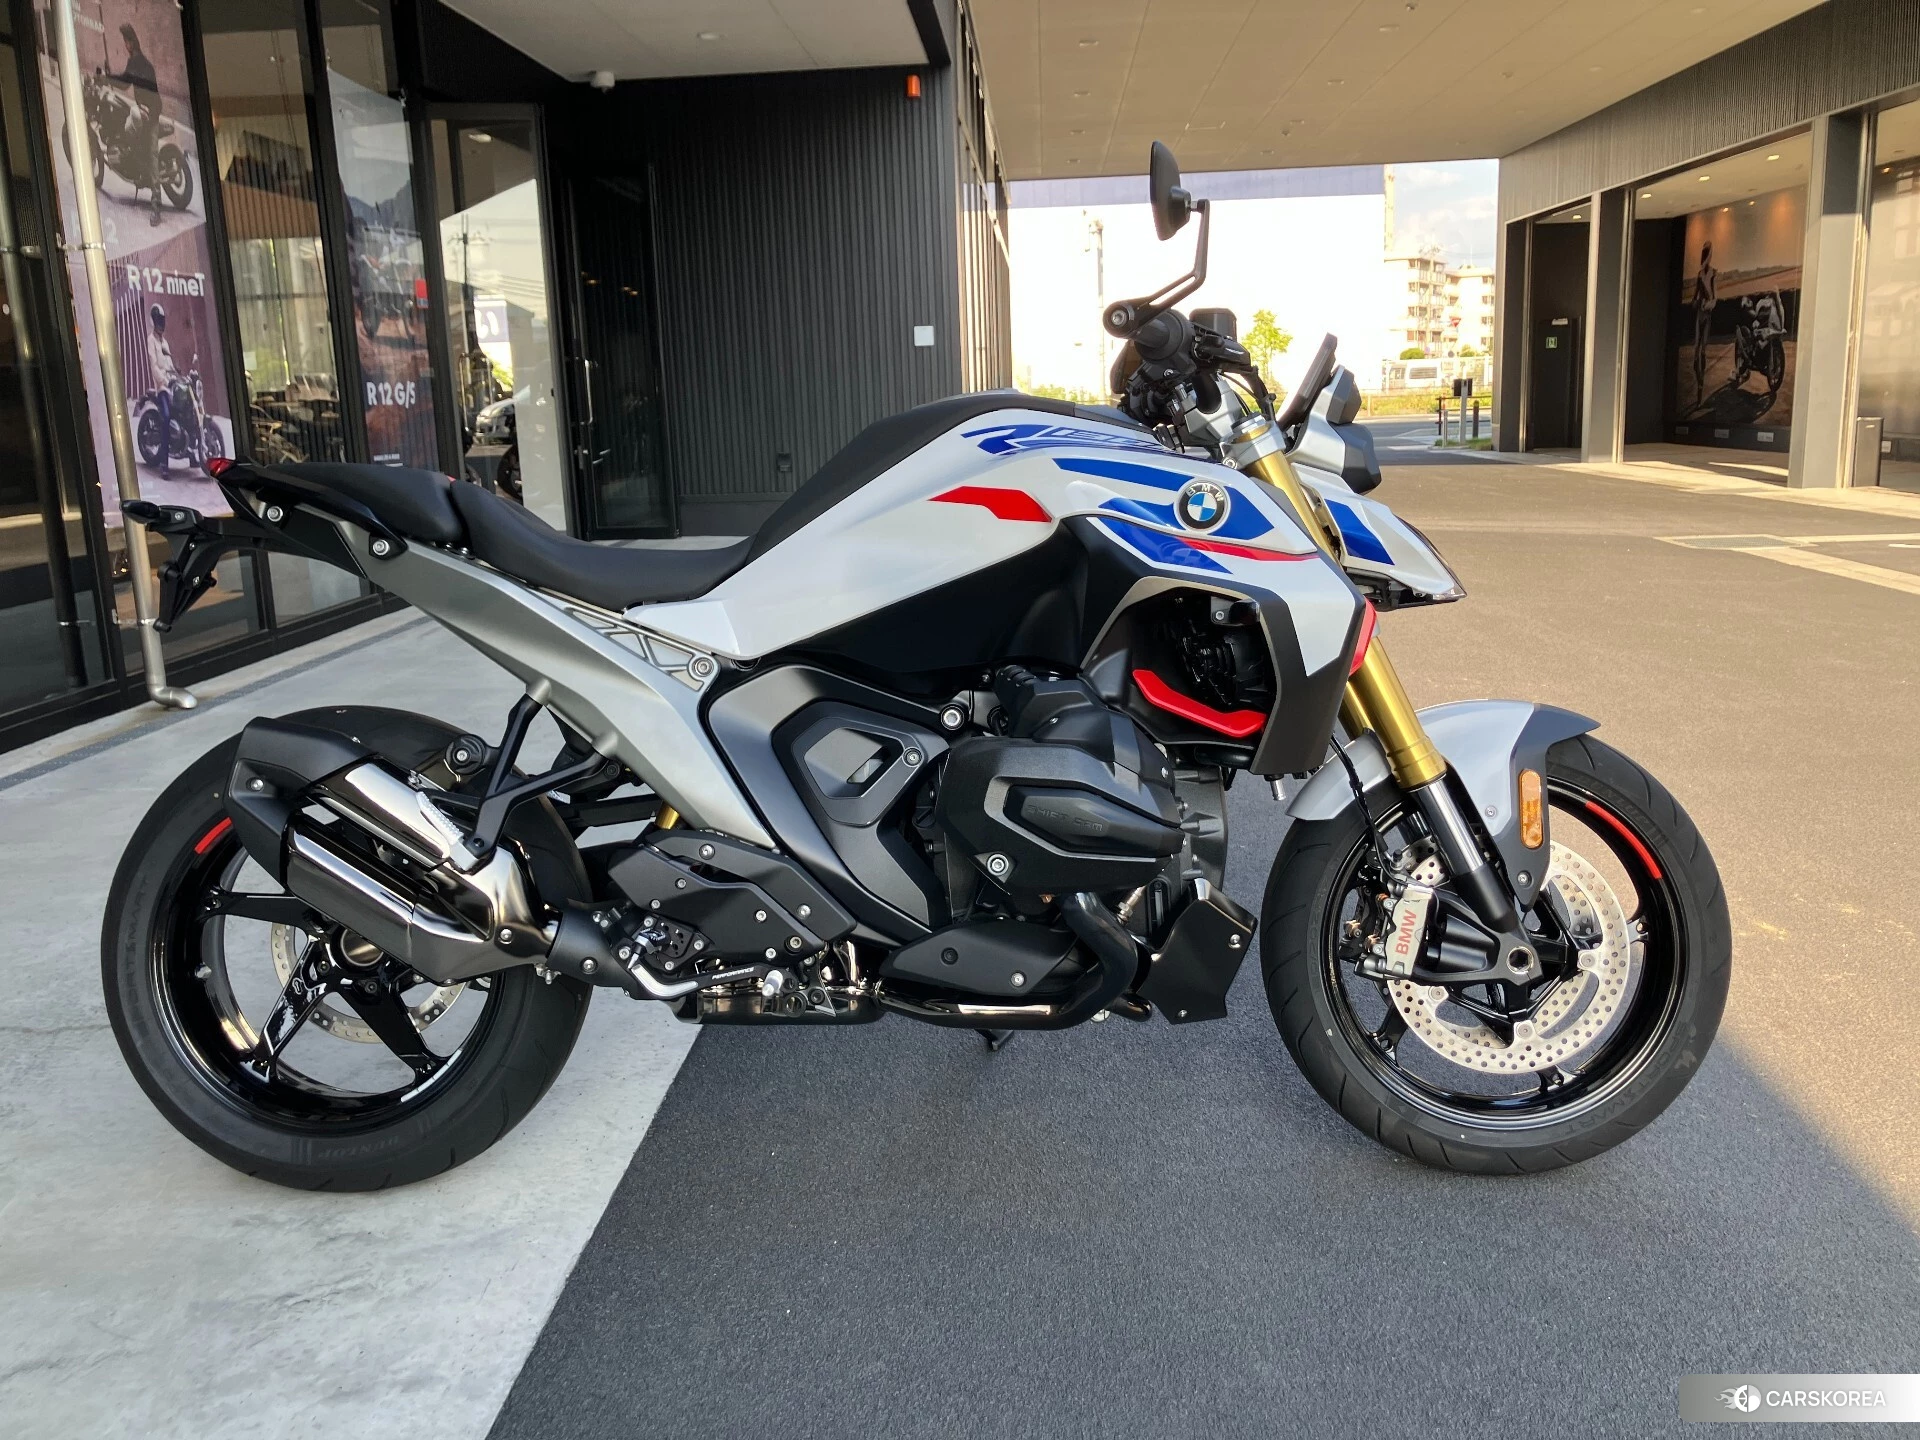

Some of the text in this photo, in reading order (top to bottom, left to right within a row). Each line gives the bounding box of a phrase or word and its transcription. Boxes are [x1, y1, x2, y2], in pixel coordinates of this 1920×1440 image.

[126, 263, 206, 297] R 12 nineT
[366, 380, 416, 409] R 12 G/S
[1186, 482, 1225, 502] BMW
[1395, 909, 1417, 955] BMW
[711, 966, 755, 980] PERFORMANCE
